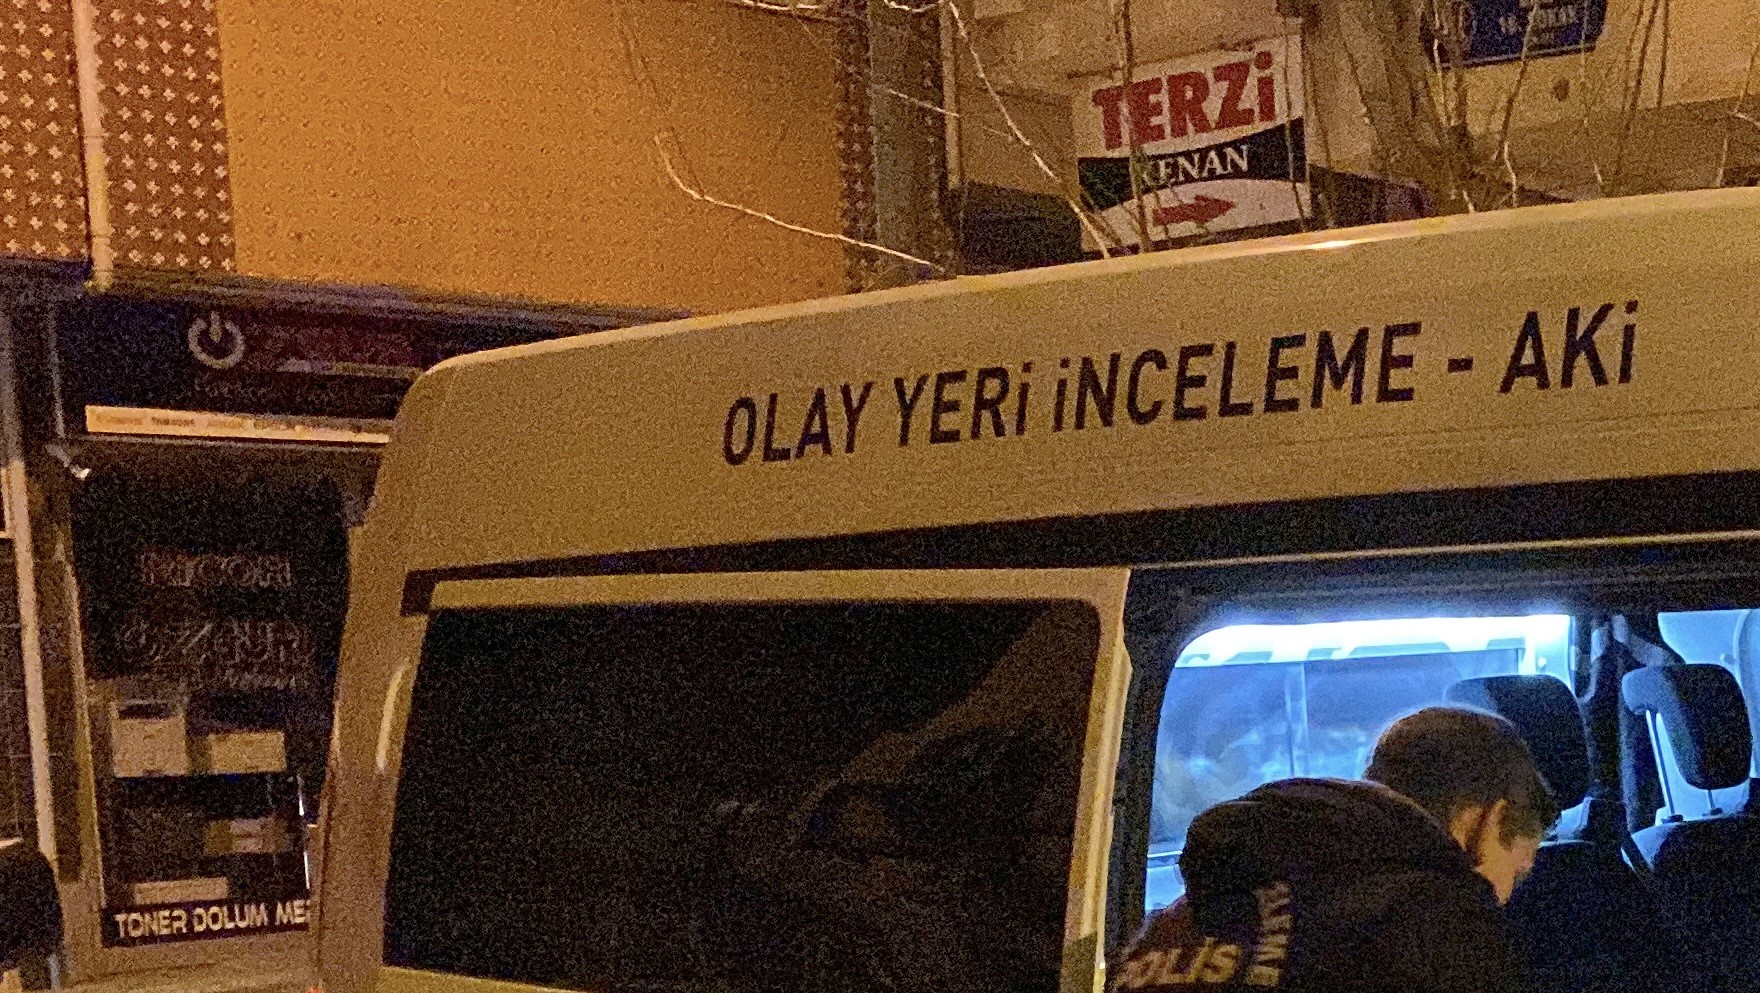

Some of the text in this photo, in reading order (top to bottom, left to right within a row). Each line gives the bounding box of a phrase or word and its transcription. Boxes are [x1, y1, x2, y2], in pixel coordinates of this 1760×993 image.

[1091, 50, 1277, 150] TERZİ
[724, 381, 873, 467] OLAY
[897, 359, 1032, 446] YERİ
[1053, 322, 1422, 433] İNCELEME
[1500, 300, 1640, 394] AKİ
[114, 907, 187, 938] TONER
[192, 902, 269, 932] DOLUM
